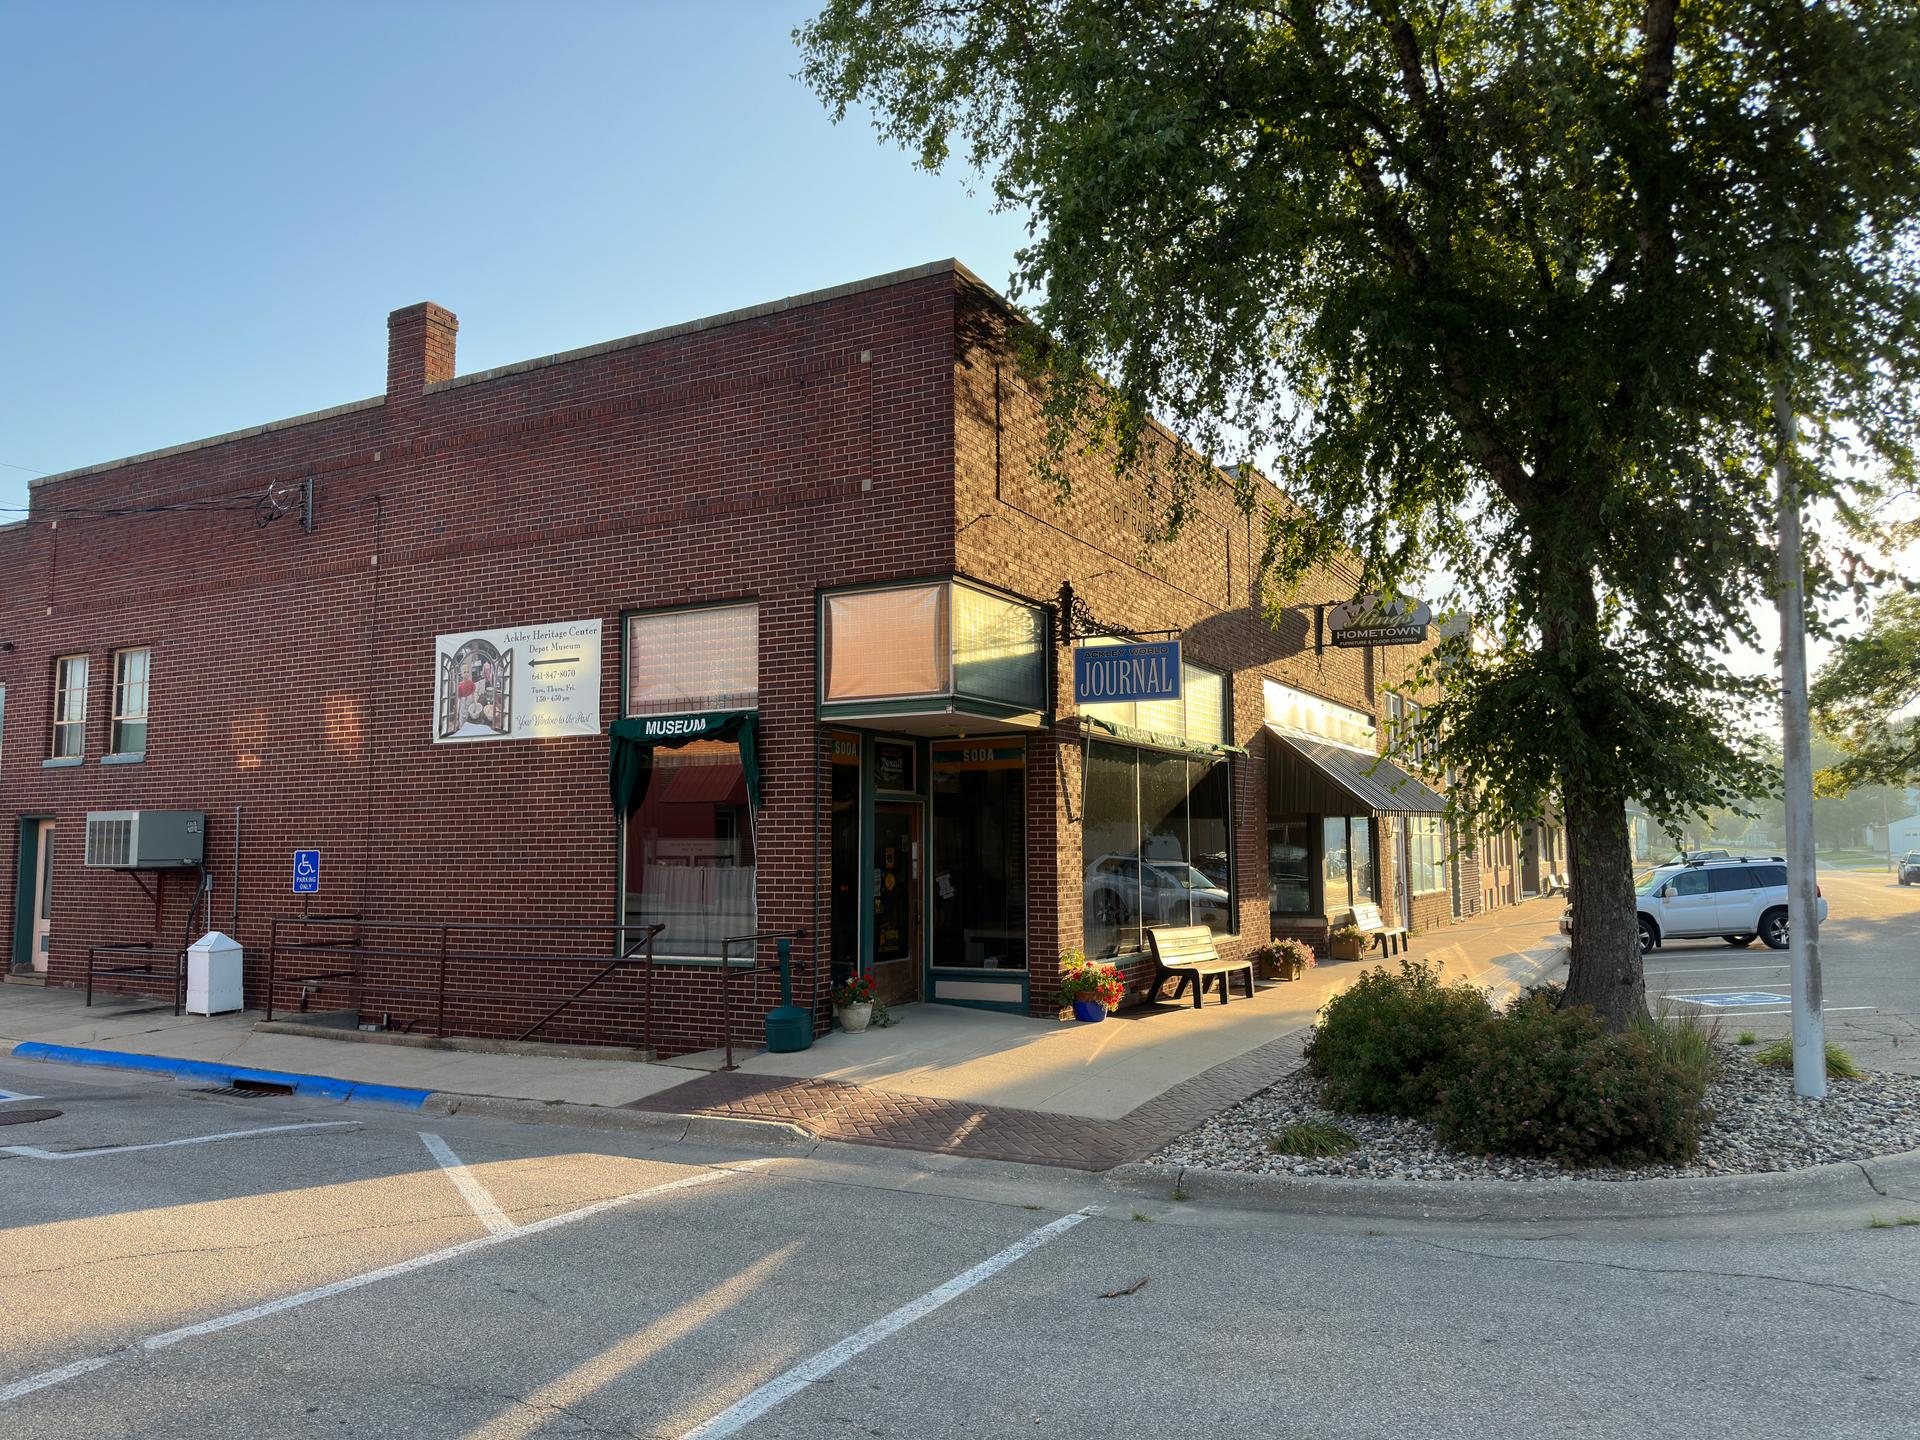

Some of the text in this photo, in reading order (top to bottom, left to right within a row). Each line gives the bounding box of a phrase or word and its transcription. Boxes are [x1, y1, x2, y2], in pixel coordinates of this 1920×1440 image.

[504, 626, 598, 643] Ackley Heritage Center
[1337, 627, 1420, 639] HOMETOWN
[529, 642, 581, 654] Depot Museum
[1084, 647, 1169, 658] ACKLEY WORLD
[532, 669, 576, 680] 641-847-8070
[1080, 657, 1173, 697] JOURNAL
[645, 718, 706, 735] MUSEUM
[835, 740, 857, 757] SODA
[963, 748, 994, 762] SODA
[880, 756, 903, 772] Rexall
